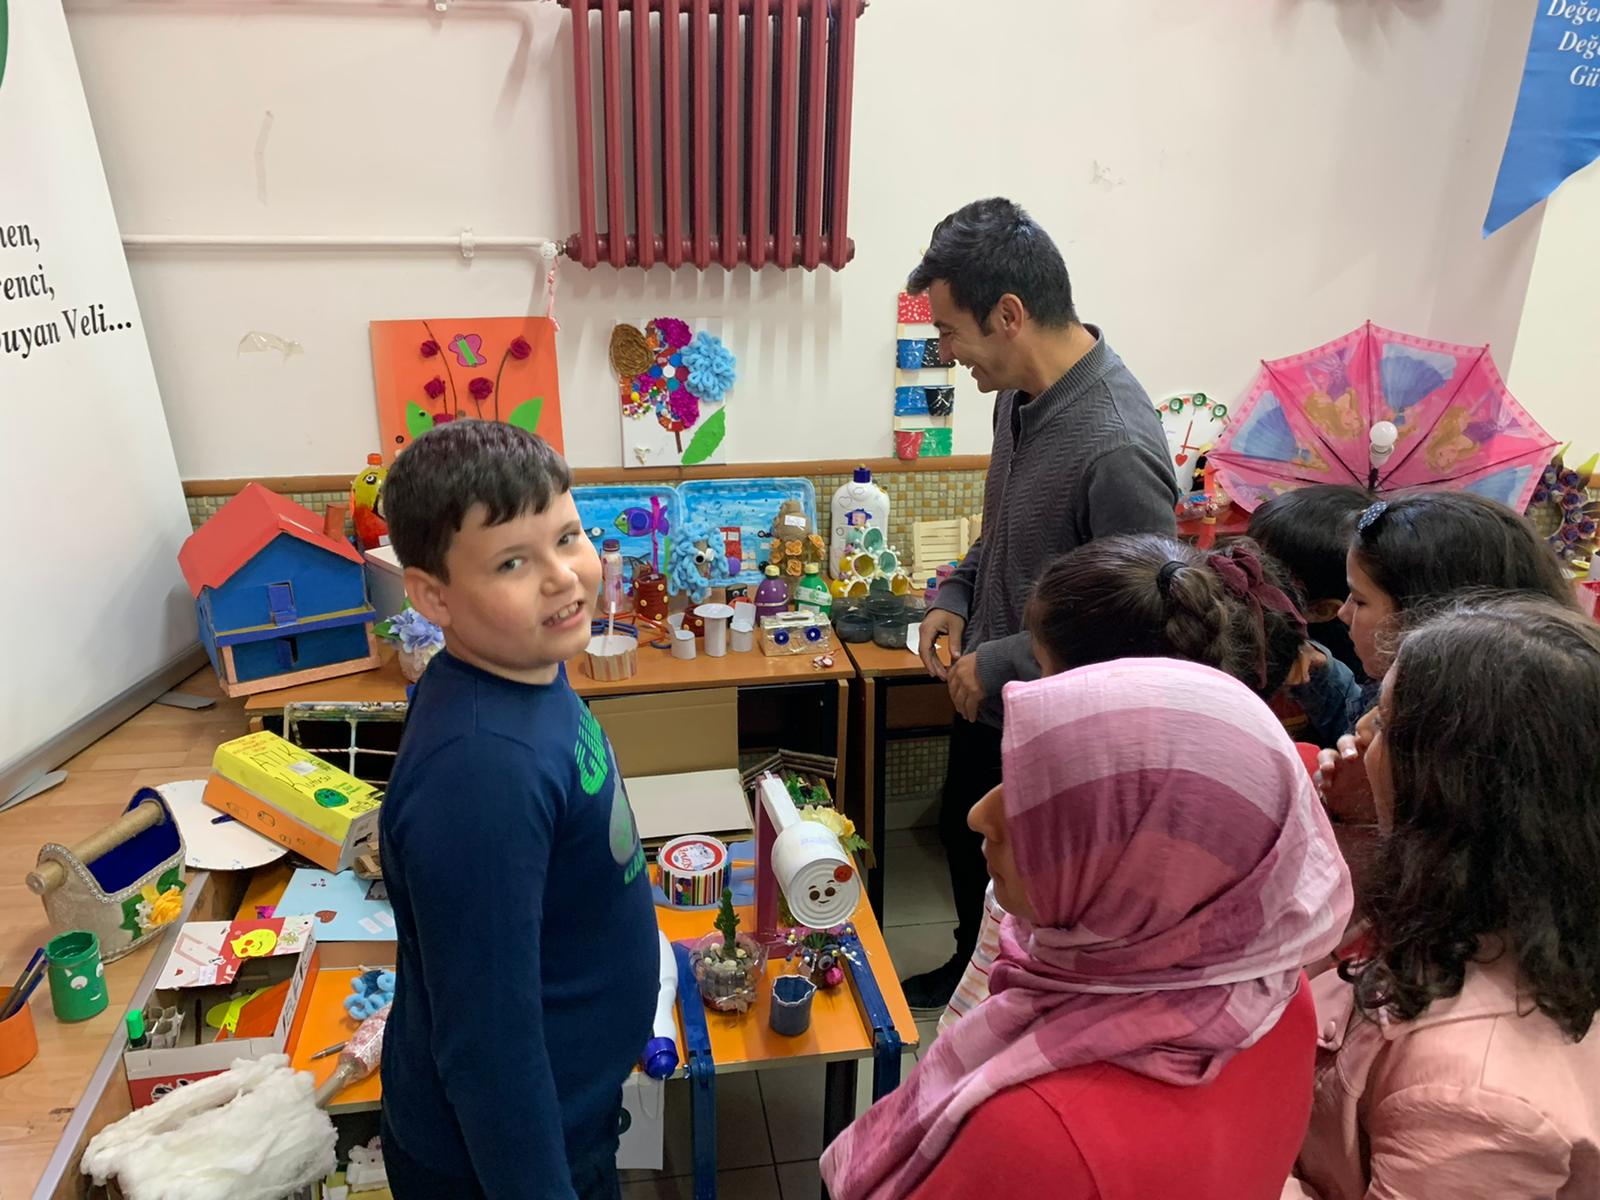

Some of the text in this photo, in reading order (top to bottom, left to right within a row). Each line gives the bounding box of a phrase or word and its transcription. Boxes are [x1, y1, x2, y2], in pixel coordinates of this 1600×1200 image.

[1558, 31, 1600, 59] Değ
[1569, 64, 1600, 87] Gü
[0, 264, 55, 301] enci,
[0, 304, 132, 359] uyan Veli...
